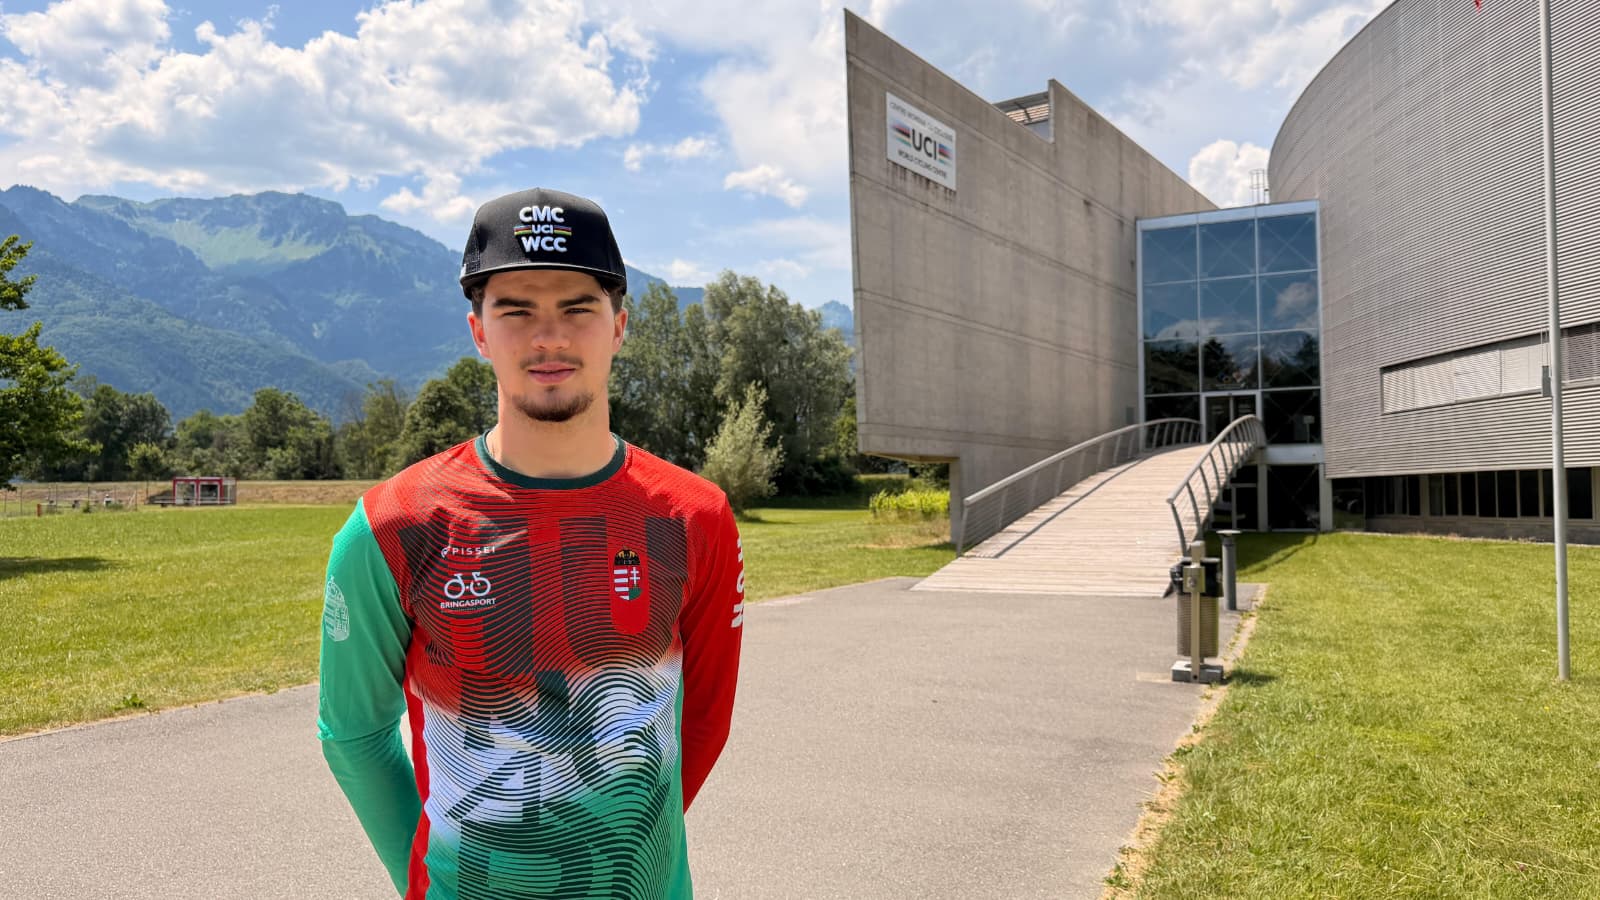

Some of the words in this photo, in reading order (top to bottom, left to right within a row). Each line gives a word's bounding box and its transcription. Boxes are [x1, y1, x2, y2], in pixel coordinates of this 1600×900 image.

[912, 128, 937, 161] UCI
[898, 149, 914, 162] WORLD
[519, 205, 565, 223] CMC
[531, 224, 554, 234] UCI
[521, 236, 568, 252] WCC
[452, 546, 496, 556] PISSEI
[440, 598, 497, 609] BRINGASPORT
